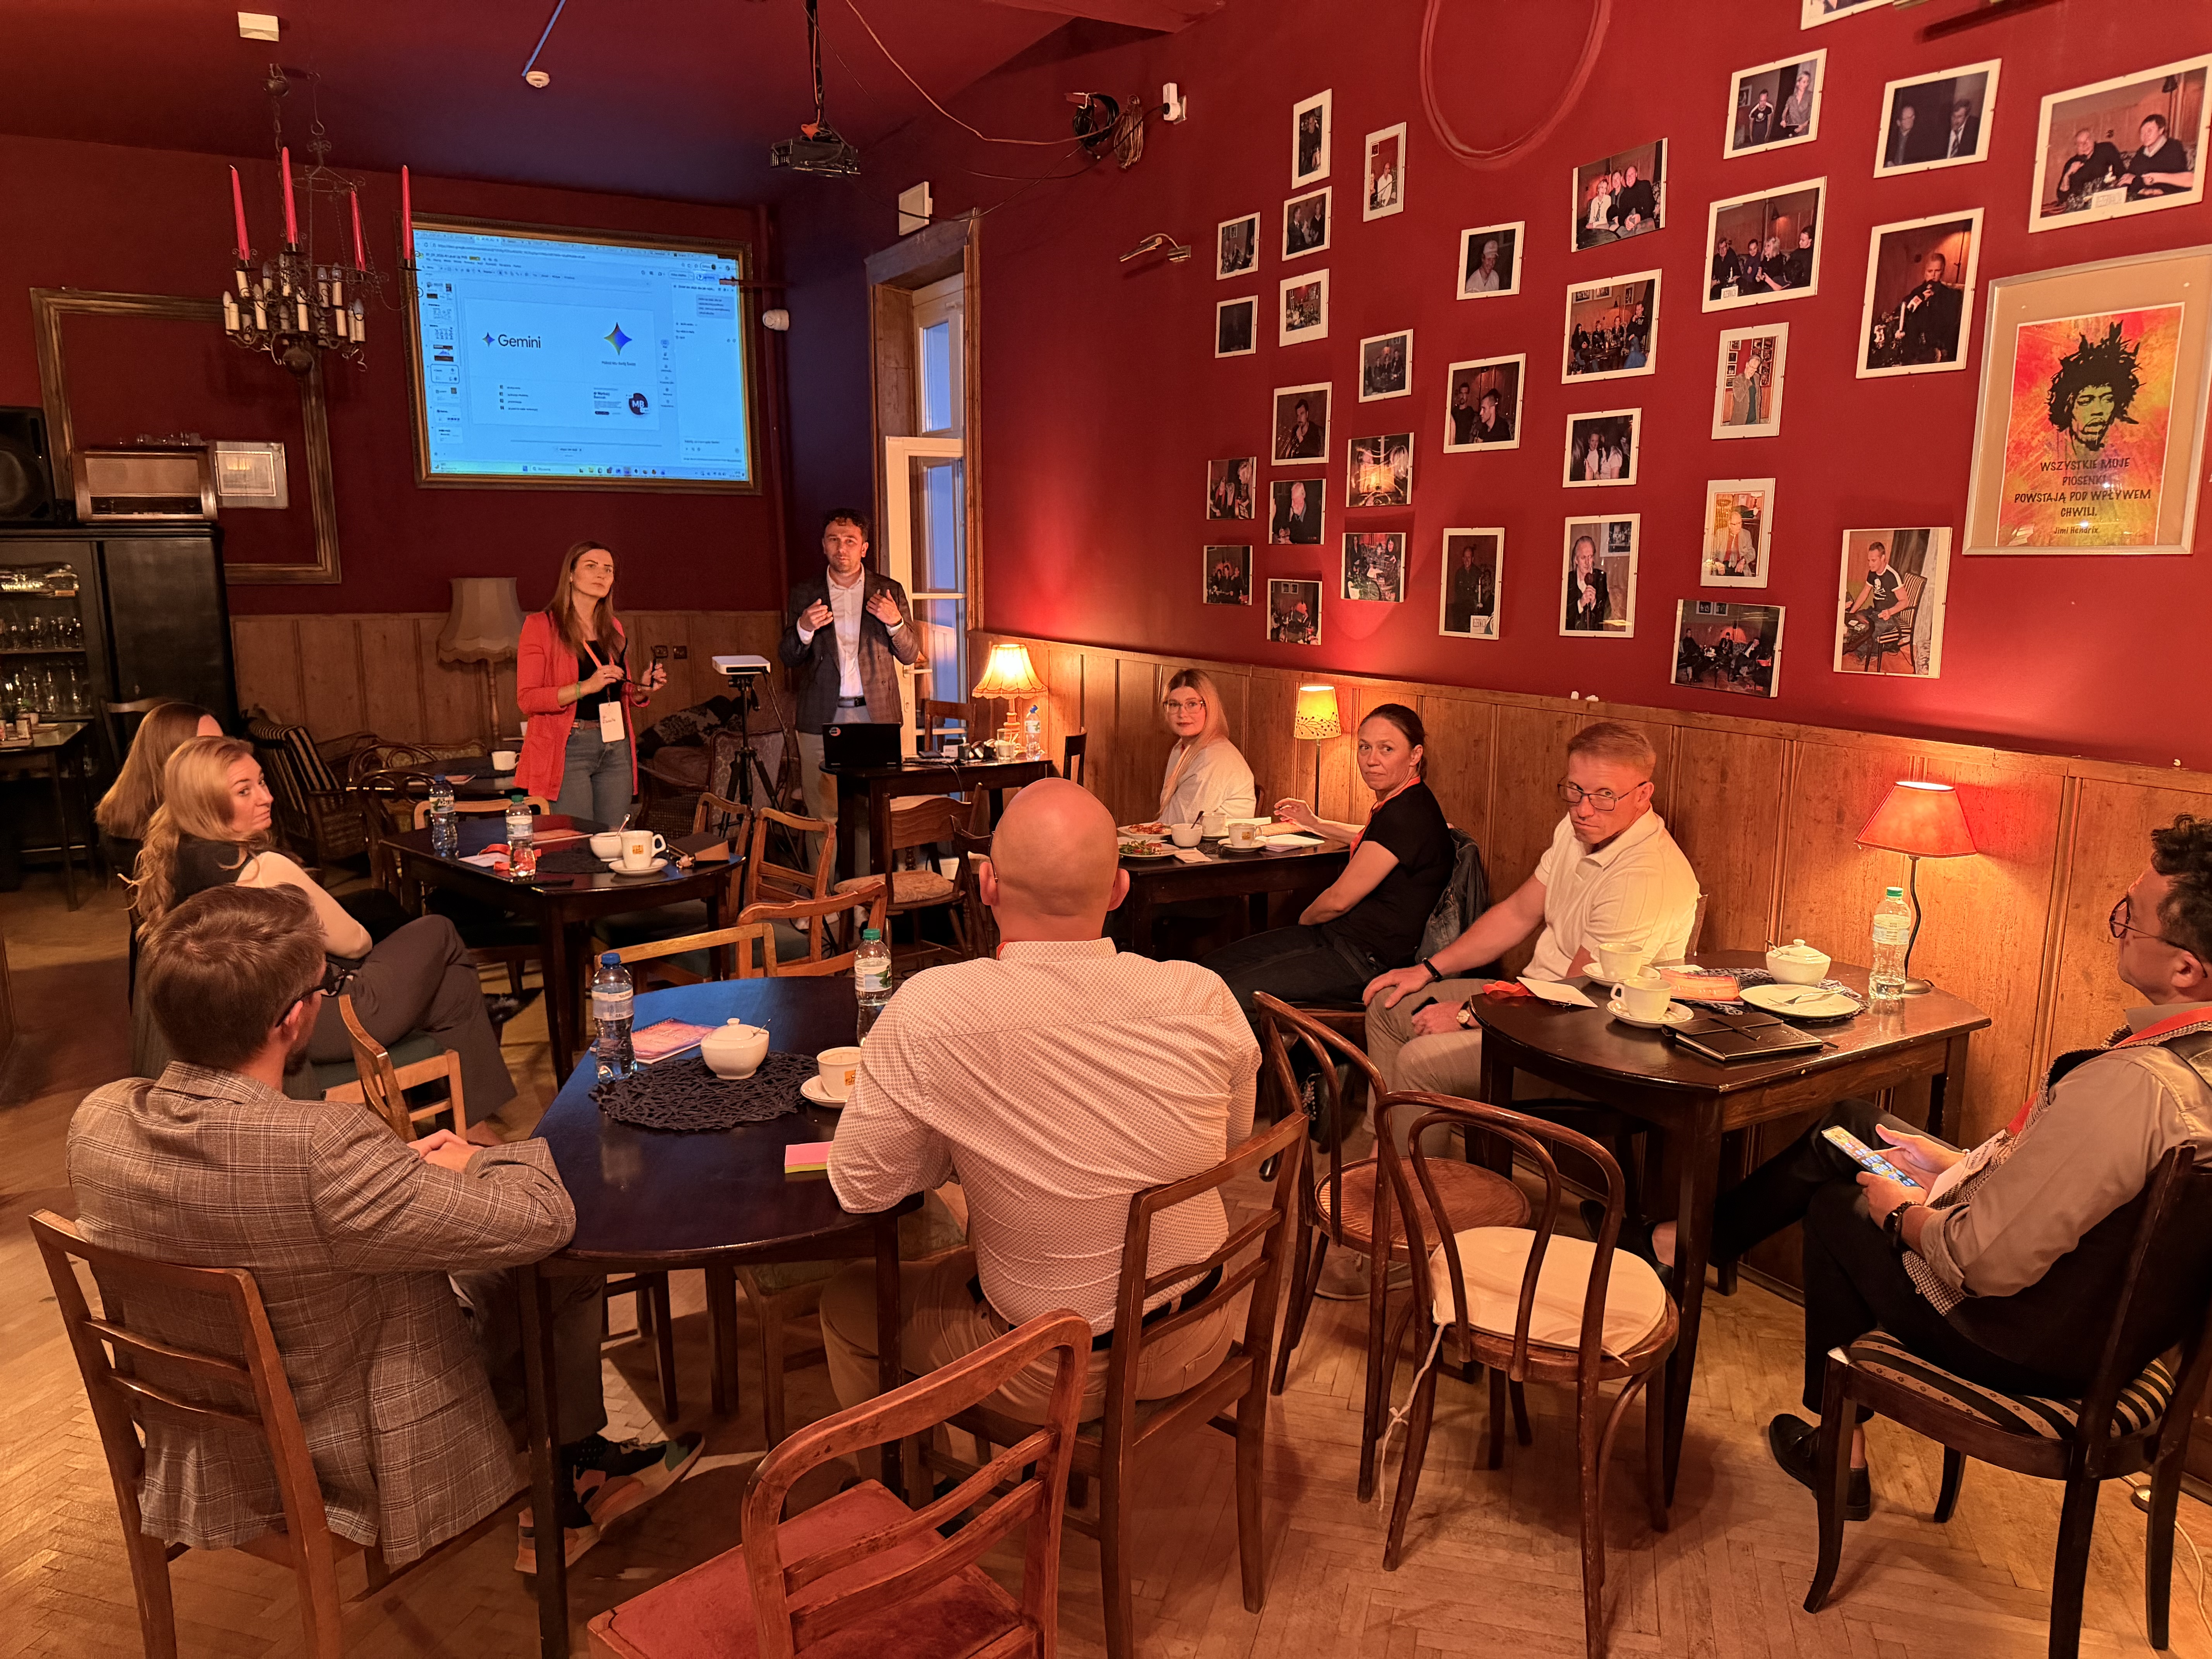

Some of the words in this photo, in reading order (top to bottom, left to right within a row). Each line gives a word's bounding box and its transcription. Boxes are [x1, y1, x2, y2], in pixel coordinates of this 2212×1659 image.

[498, 334, 541, 349] Gemini
[632, 400, 644, 408] MB
[2040, 459, 2097, 471] WSZYSTKIE
[2100, 458, 2131, 468] MOJE
[2014, 492, 2066, 503] POWSTAJĄ
[2070, 492, 2087, 501] POD
[2091, 489, 2151, 501] WPŁYWEM
[2061, 507, 2097, 517] CHWILI.
